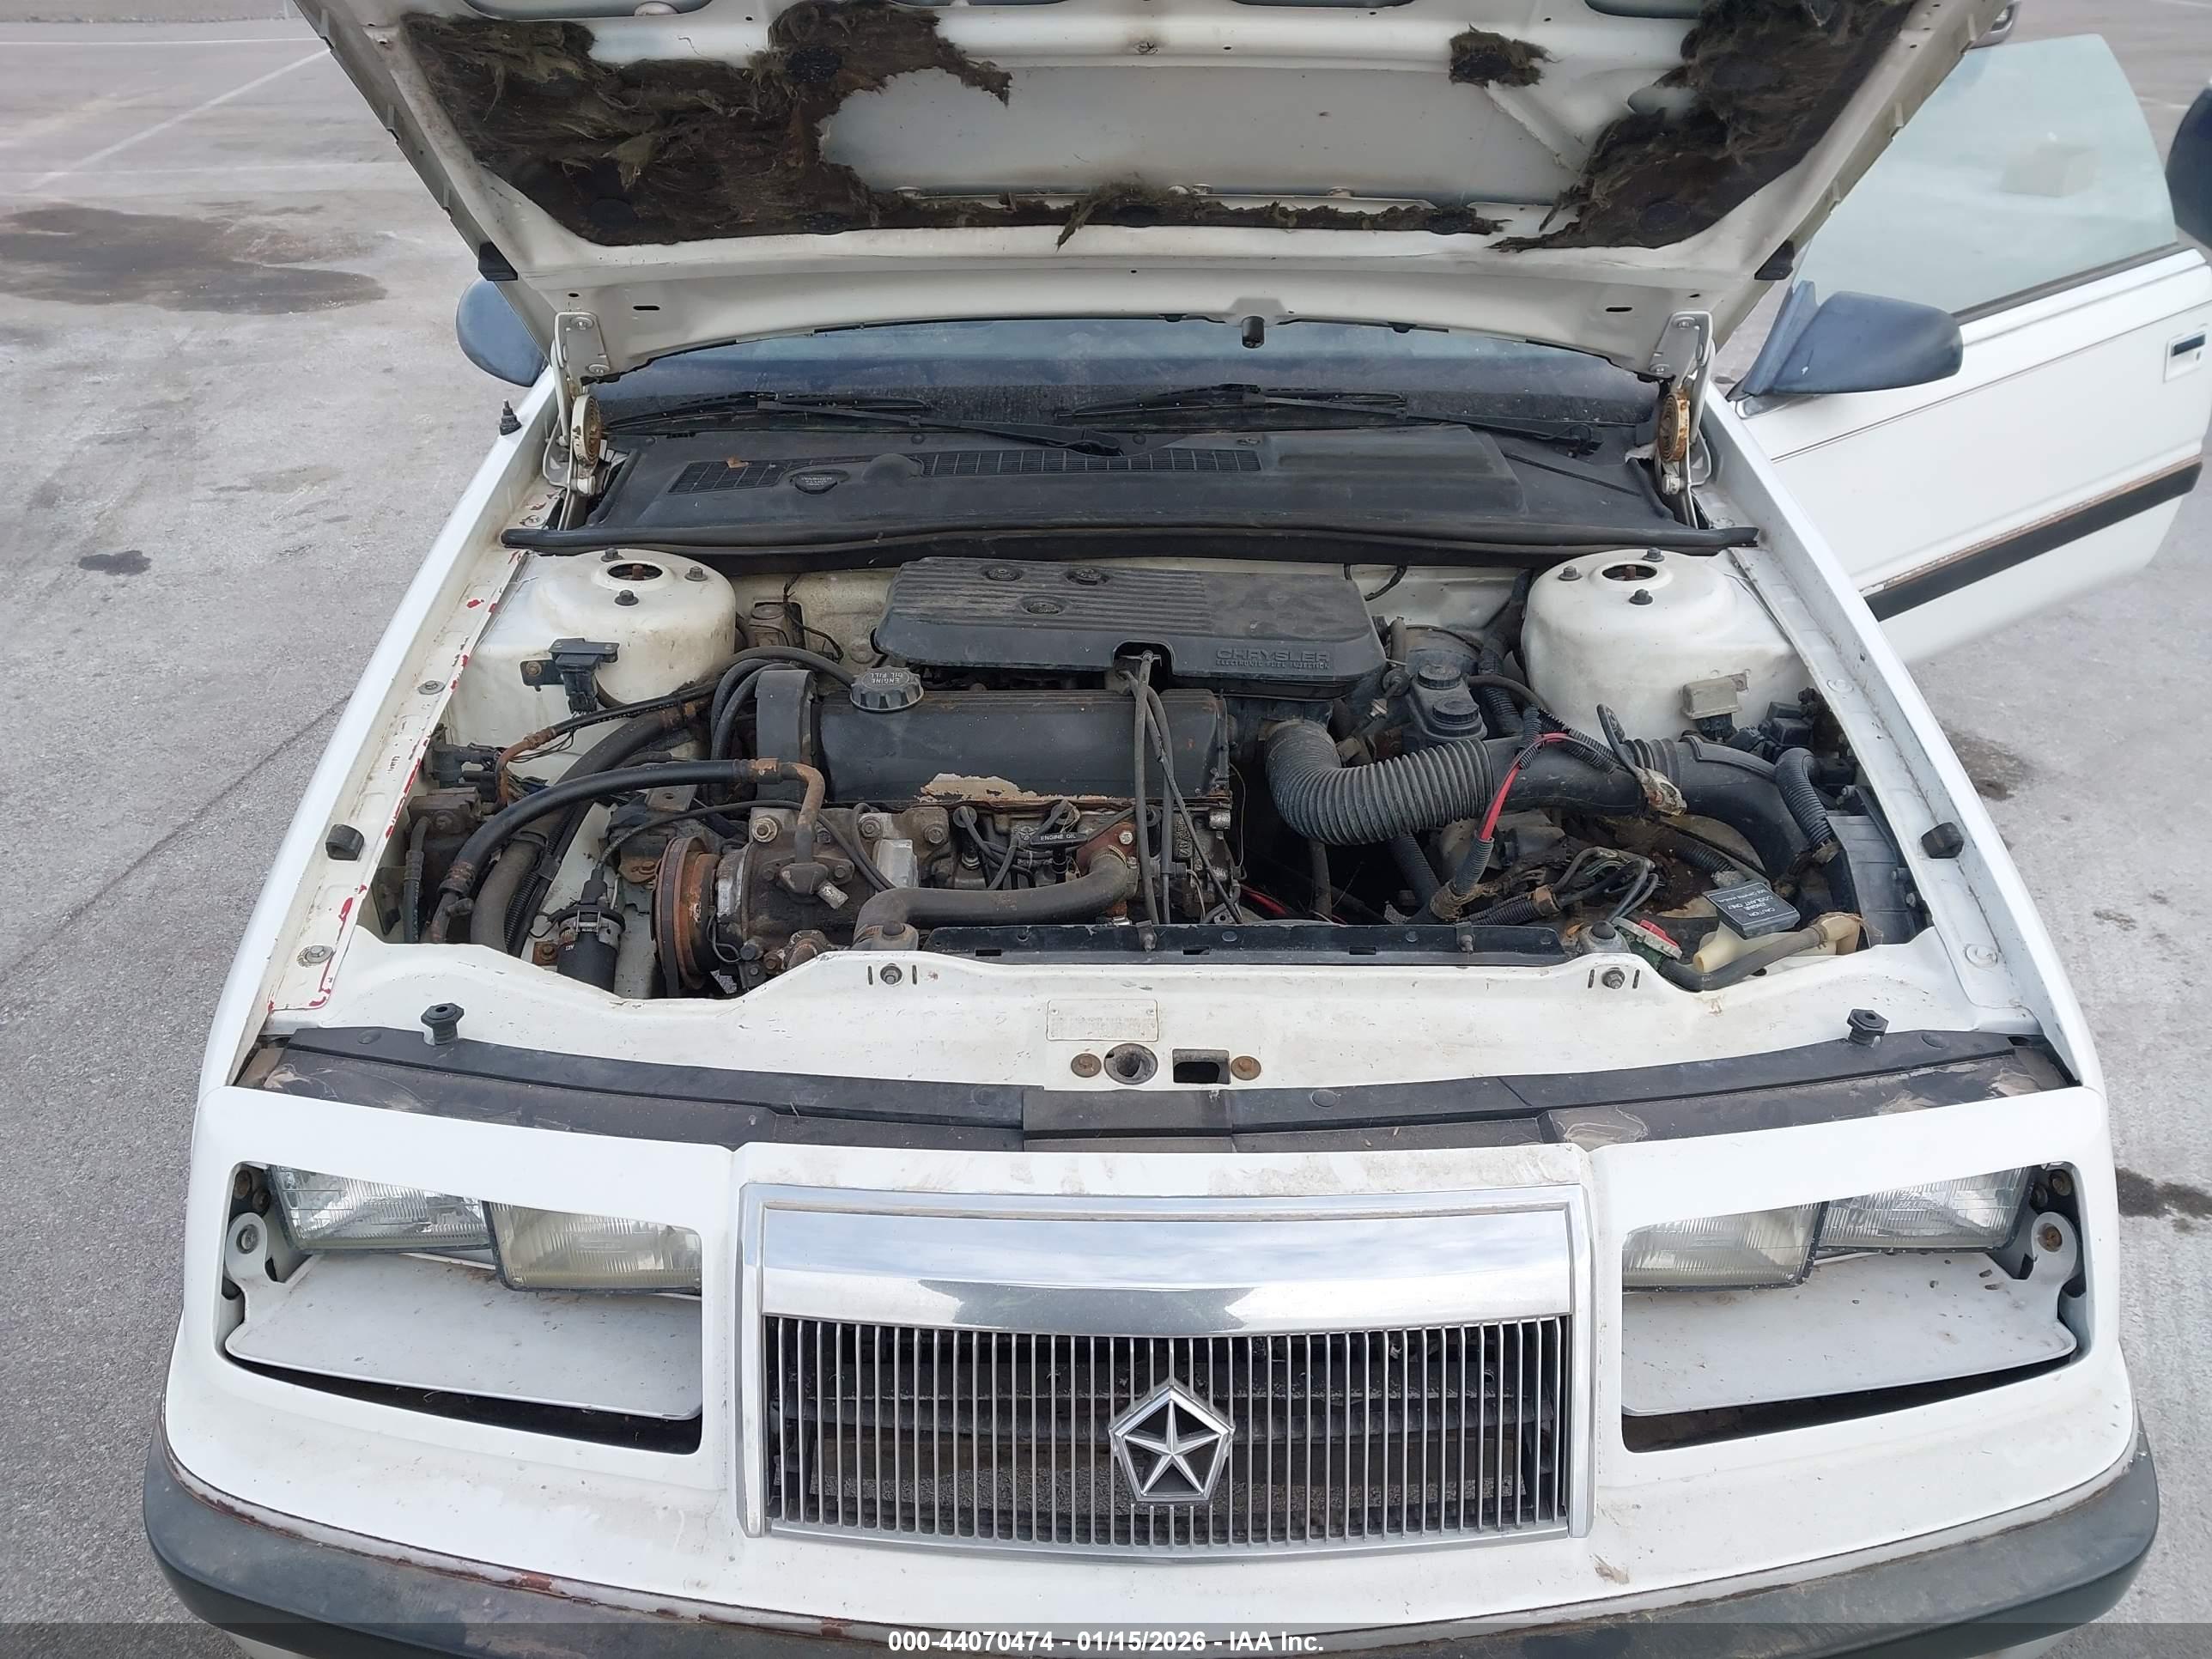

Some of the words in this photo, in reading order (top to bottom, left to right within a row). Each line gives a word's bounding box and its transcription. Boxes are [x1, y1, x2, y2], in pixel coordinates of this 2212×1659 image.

[1216, 648, 1330, 662] CHRYSLER
[1216, 659, 1263, 667] ELECTRONIC
[1744, 896, 1773, 905] COOLANT
[1747, 907, 1776, 917] CAUTION
